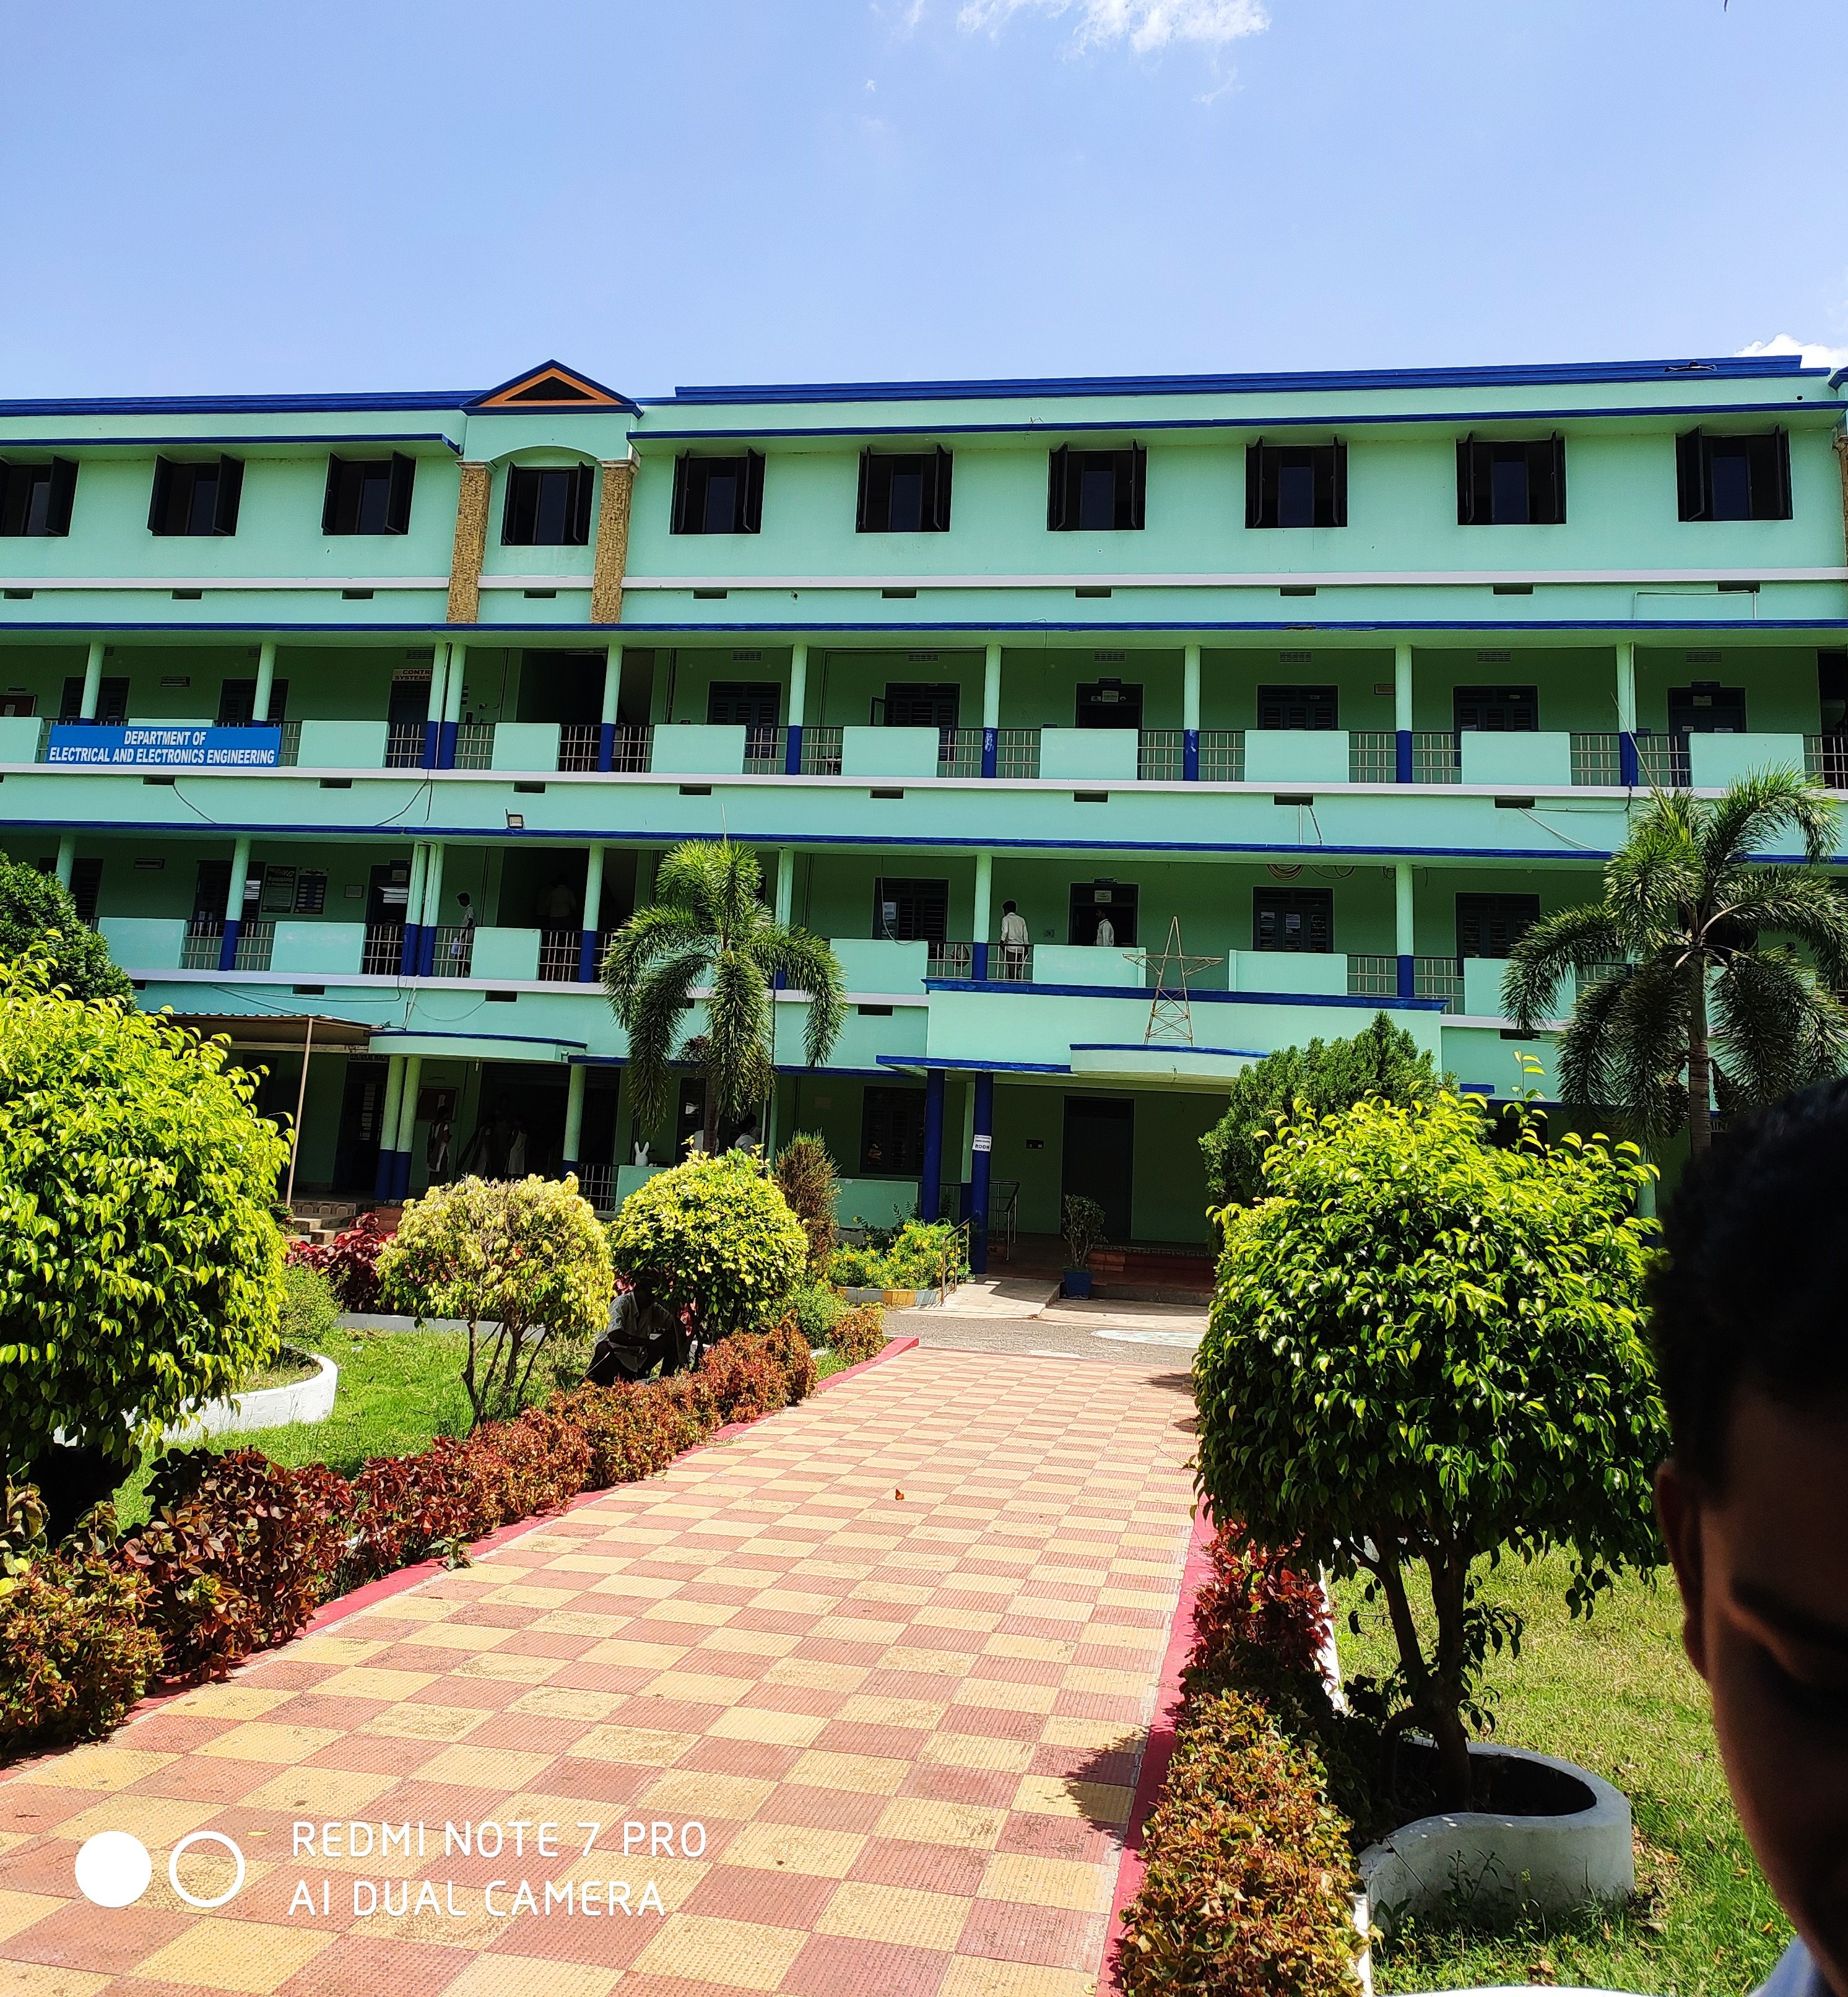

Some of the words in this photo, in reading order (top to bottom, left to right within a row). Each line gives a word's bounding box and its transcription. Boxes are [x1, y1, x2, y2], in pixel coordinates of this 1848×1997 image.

[124, 731, 191, 745] DEPARTMENT
[193, 731, 207, 746] OF
[49, 747, 110, 762] ELECTRICAL
[112, 748, 134, 762] AND
[136, 748, 204, 764] ELECTRONICS
[206, 749, 275, 764] ENGINEERING
